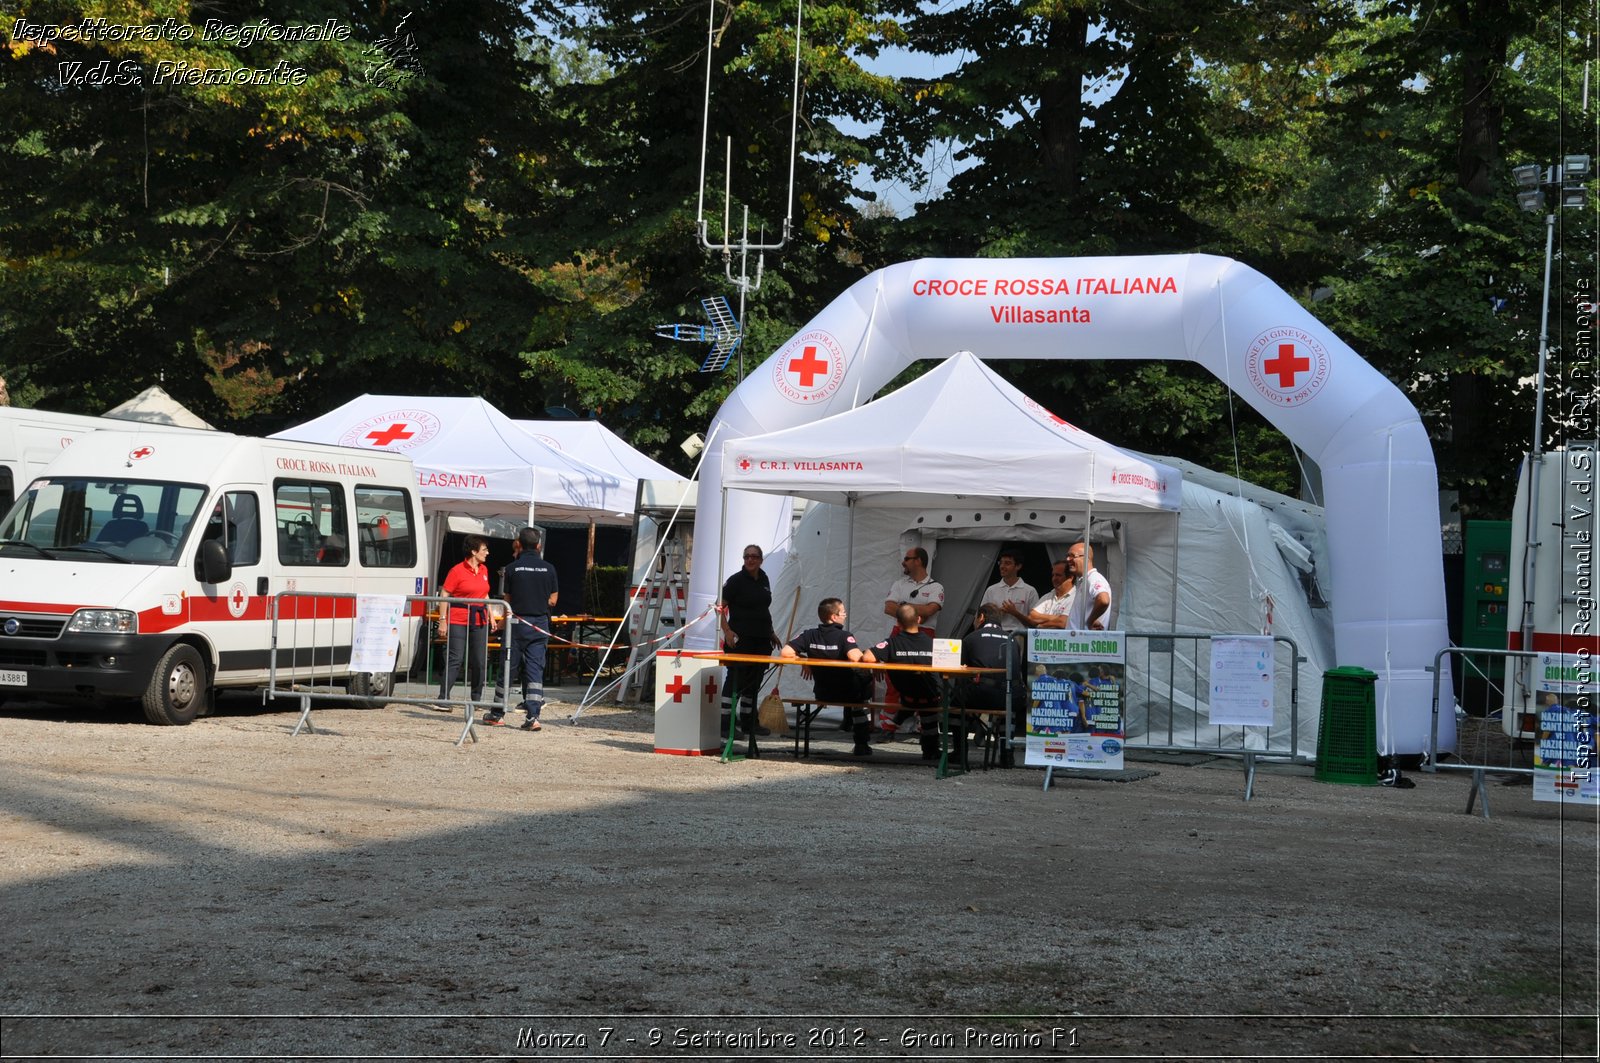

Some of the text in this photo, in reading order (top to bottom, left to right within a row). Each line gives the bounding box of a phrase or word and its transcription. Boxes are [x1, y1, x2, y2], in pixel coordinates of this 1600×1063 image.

[912, 277, 1178, 296] CROCE ROSSA ITALIANA
[990, 306, 1091, 323] Villasanta
[792, 340, 801, 348] DI
[801, 333, 833, 348] GINEVRA
[1258, 335, 1270, 346] DI
[1270, 329, 1313, 345] GINEVRA
[1248, 345, 1283, 402] CONVENZIONE
[1294, 387, 1313, 402] 1864
[276, 457, 377, 478] CROCE ROSSA ITALIANA
[760, 461, 790, 470] C.R.I.
[793, 462, 863, 471] VILLASANTA
[419, 472, 487, 488] LASANTA
[1034, 638, 1067, 652] GIOCARE
[1069, 642, 1080, 652] PER
[1091, 640, 1118, 654] SOGNO
[0, 673, 26, 683] A388C
[1031, 682, 1069, 692] NAZIONALE
[1031, 691, 1066, 701] CANTANTI
[1031, 708, 1069, 717] NAZIONALE
[1031, 717, 1074, 727] FARMACISTI
